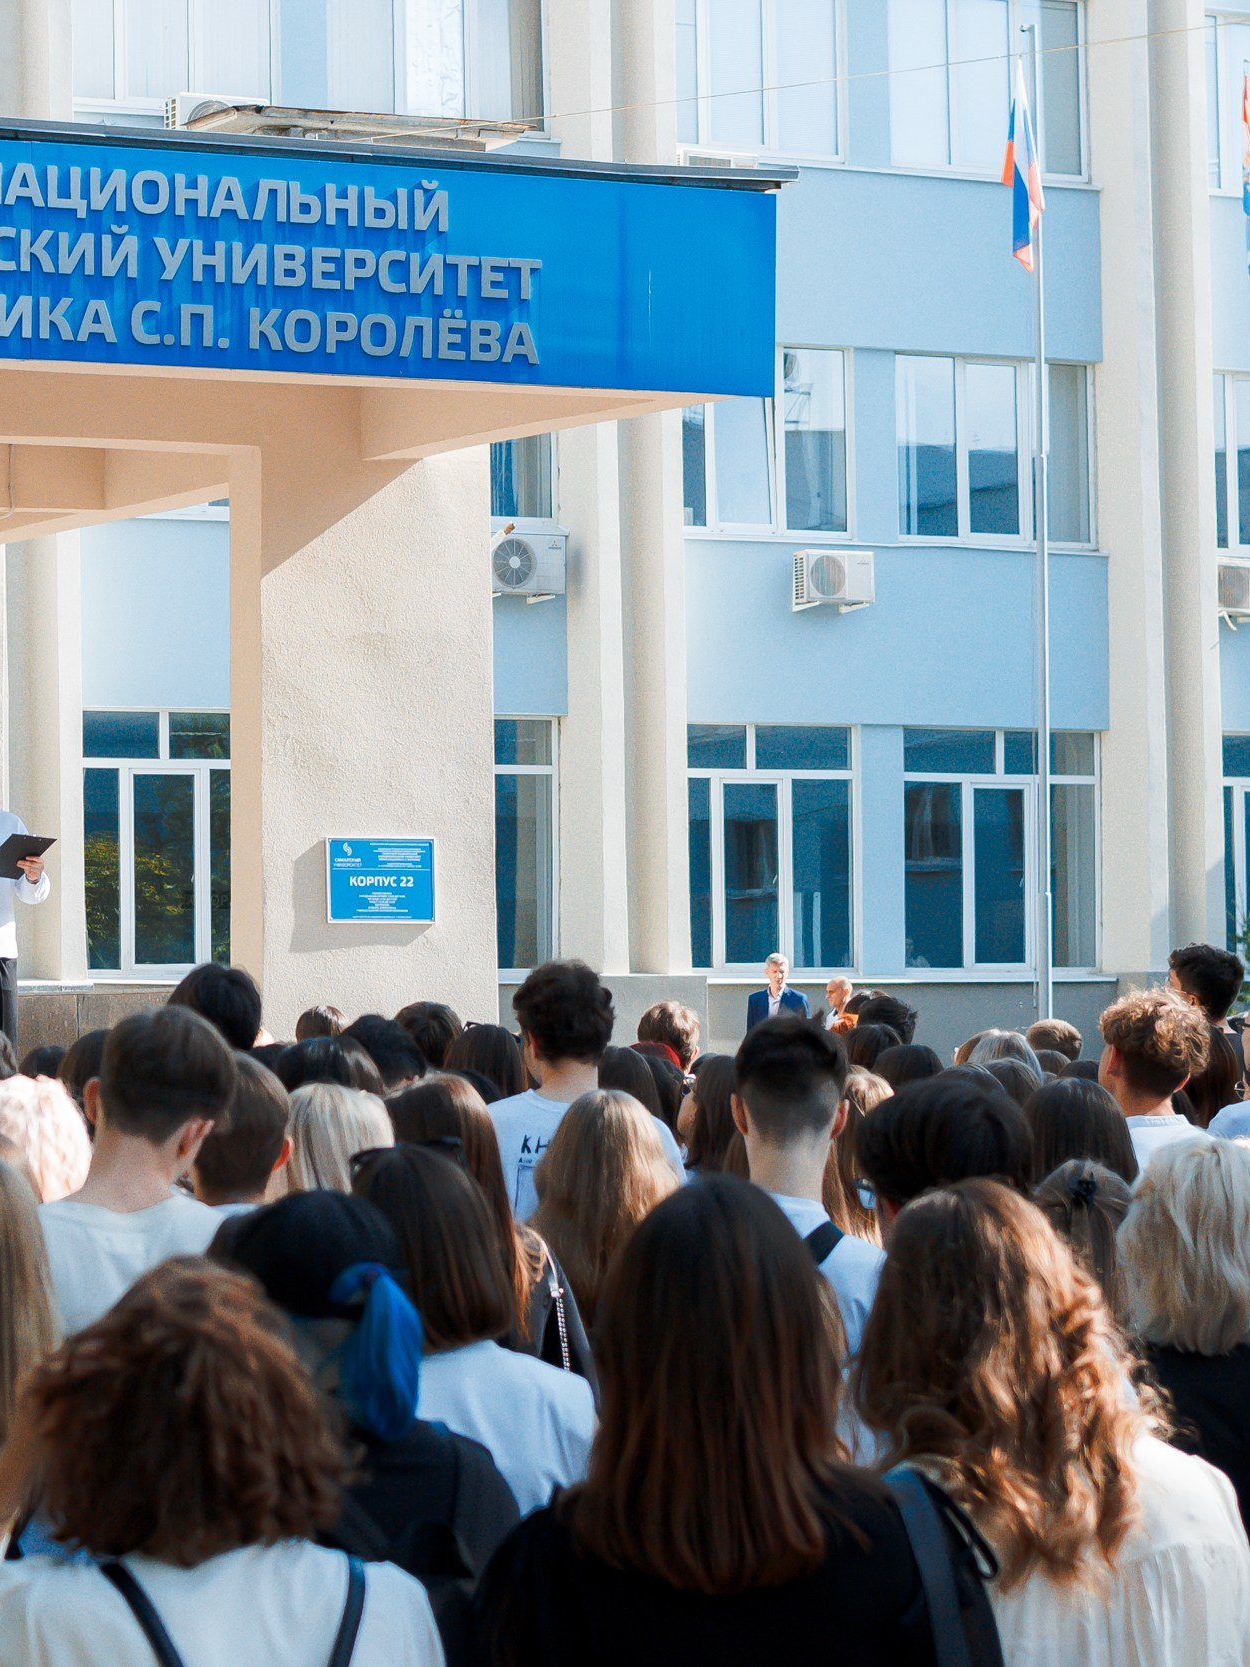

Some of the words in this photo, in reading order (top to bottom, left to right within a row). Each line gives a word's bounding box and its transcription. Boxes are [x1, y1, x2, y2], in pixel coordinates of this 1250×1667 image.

[153, 236, 542, 300] УНИВЕРСИТЕТ
[130, 300, 230, 349] С.П.
[249, 307, 540, 366] КОРОЛЁВА
[349, 876, 397, 887] КОРПУС
[399, 876, 414, 887] 22
